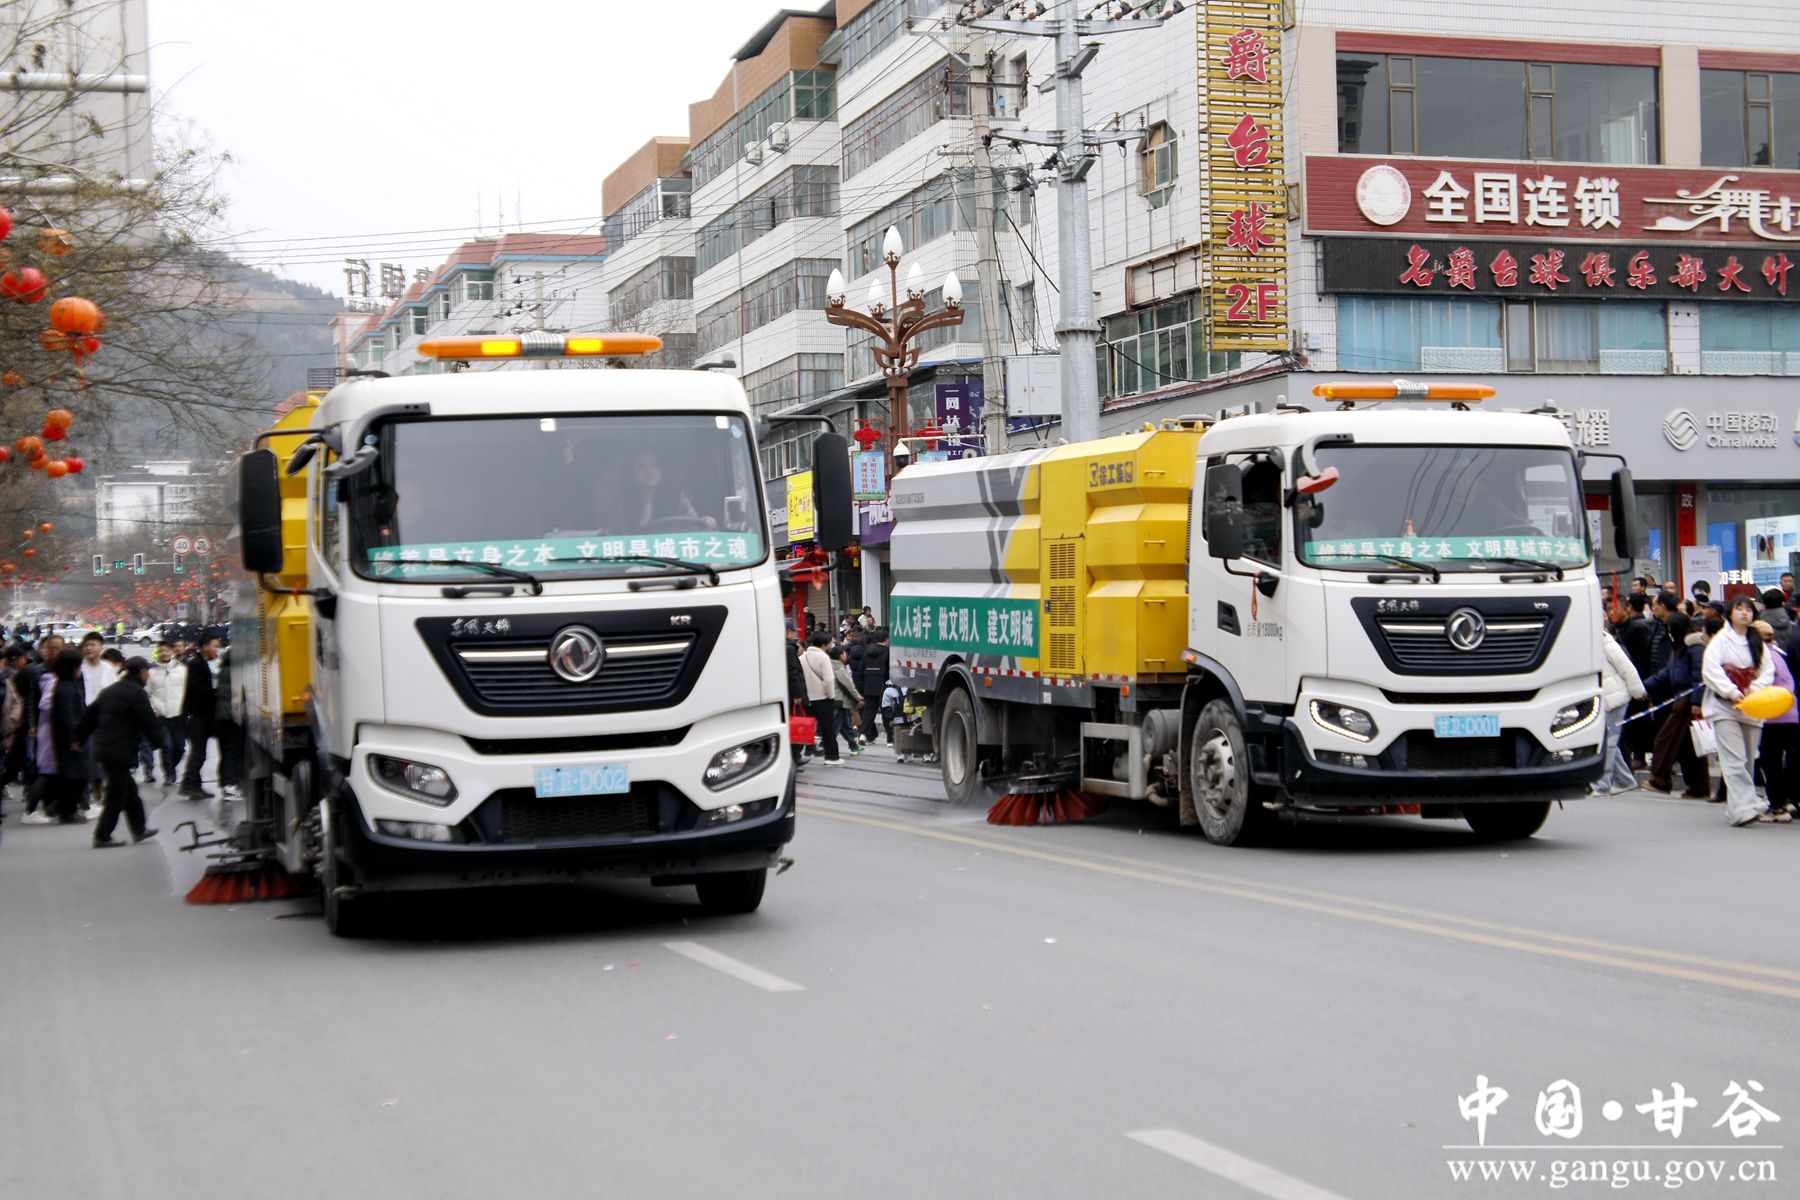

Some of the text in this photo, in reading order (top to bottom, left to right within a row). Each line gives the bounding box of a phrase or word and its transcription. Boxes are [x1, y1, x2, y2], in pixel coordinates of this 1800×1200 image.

[1422, 170, 1622, 230] 全国连锁
[1227, 283, 1279, 321] 2F
[1706, 411, 1778, 433] 中国移动
[1706, 434, 1778, 449] China Mobile
[373, 537, 748, 577] 修养是立身之本 文明是城市之魂
[1318, 540, 1453, 562] 修养是立身之本
[669, 615, 692, 627] KR
[893, 605, 1034, 648] 人人动手 做文明人 建文明城
